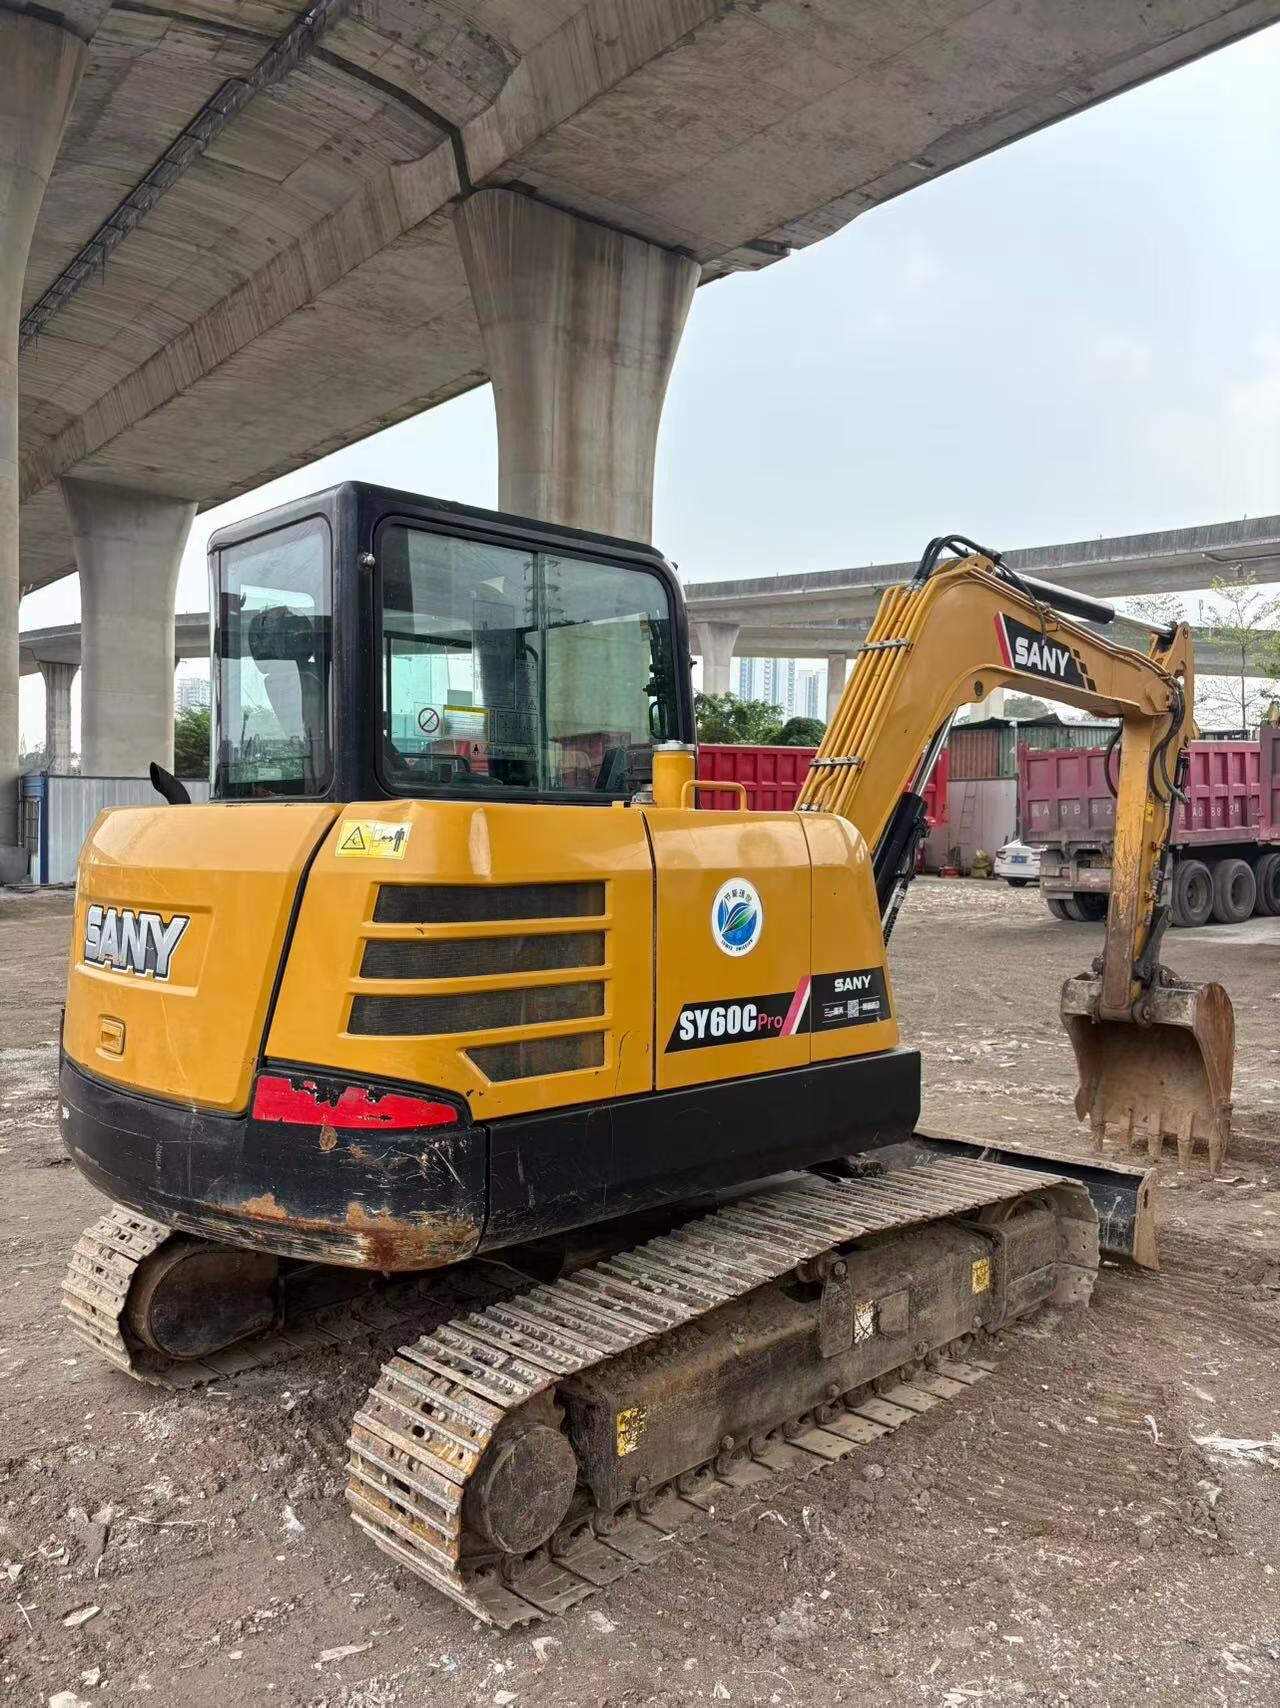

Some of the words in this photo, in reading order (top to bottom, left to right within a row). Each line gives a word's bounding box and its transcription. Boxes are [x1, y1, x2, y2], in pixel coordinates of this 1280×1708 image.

[1015, 636, 1070, 677] SANY
[85, 904, 190, 981] SANY
[834, 974, 872, 993] SANY
[679, 1003, 757, 1041] SY60C
[757, 1013, 783, 1031] Pro
